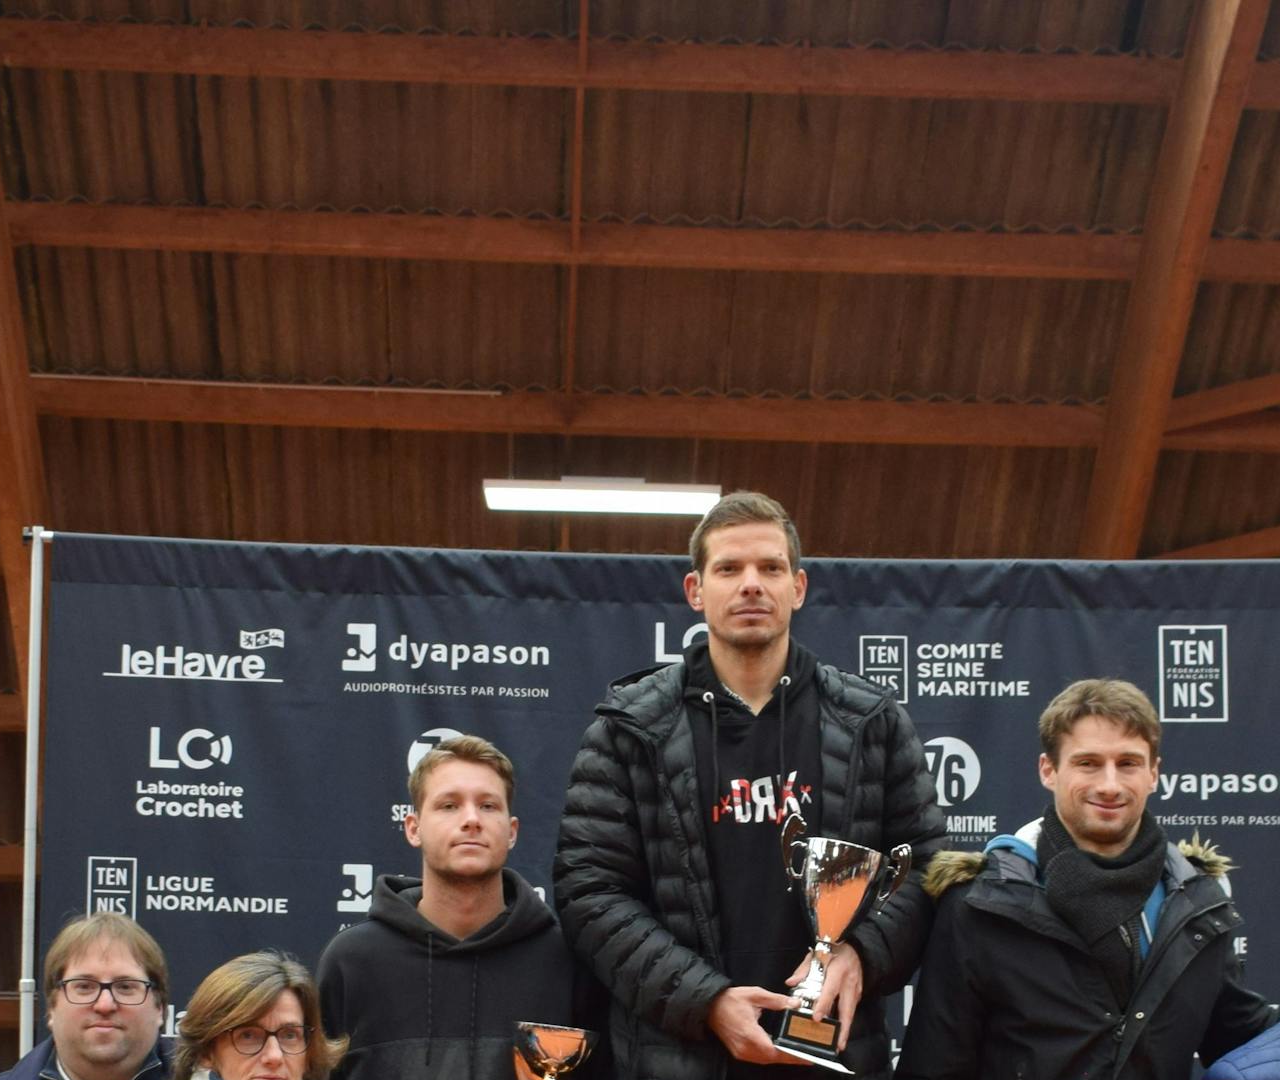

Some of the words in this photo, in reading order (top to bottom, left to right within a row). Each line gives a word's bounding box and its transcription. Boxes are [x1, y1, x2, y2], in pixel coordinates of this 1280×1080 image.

[388, 634, 550, 671] dyapason
[868, 645, 899, 664] TEN
[916, 642, 1004, 660] COMITÉ
[1169, 640, 1214, 665] TEN
[121, 643, 266, 680] leHavre
[917, 662, 985, 678] SEINE
[343, 682, 467, 696] AUDIOPROTHÉSISTES
[471, 686, 495, 697] PAR
[498, 687, 550, 698] PASSION
[917, 681, 1031, 697] MARITIME
[1173, 682, 1215, 707] NIS
[136, 780, 244, 797] Laboratoire
[136, 797, 244, 818] Crochet
[1155, 814, 1217, 826] THÉSISTES
[1221, 815, 1245, 826] PAR
[96, 867, 128, 886] TEN
[146, 876, 215, 893] LIGUE
[96, 898, 127, 915] NIS
[146, 895, 288, 914] NORMANDIE
